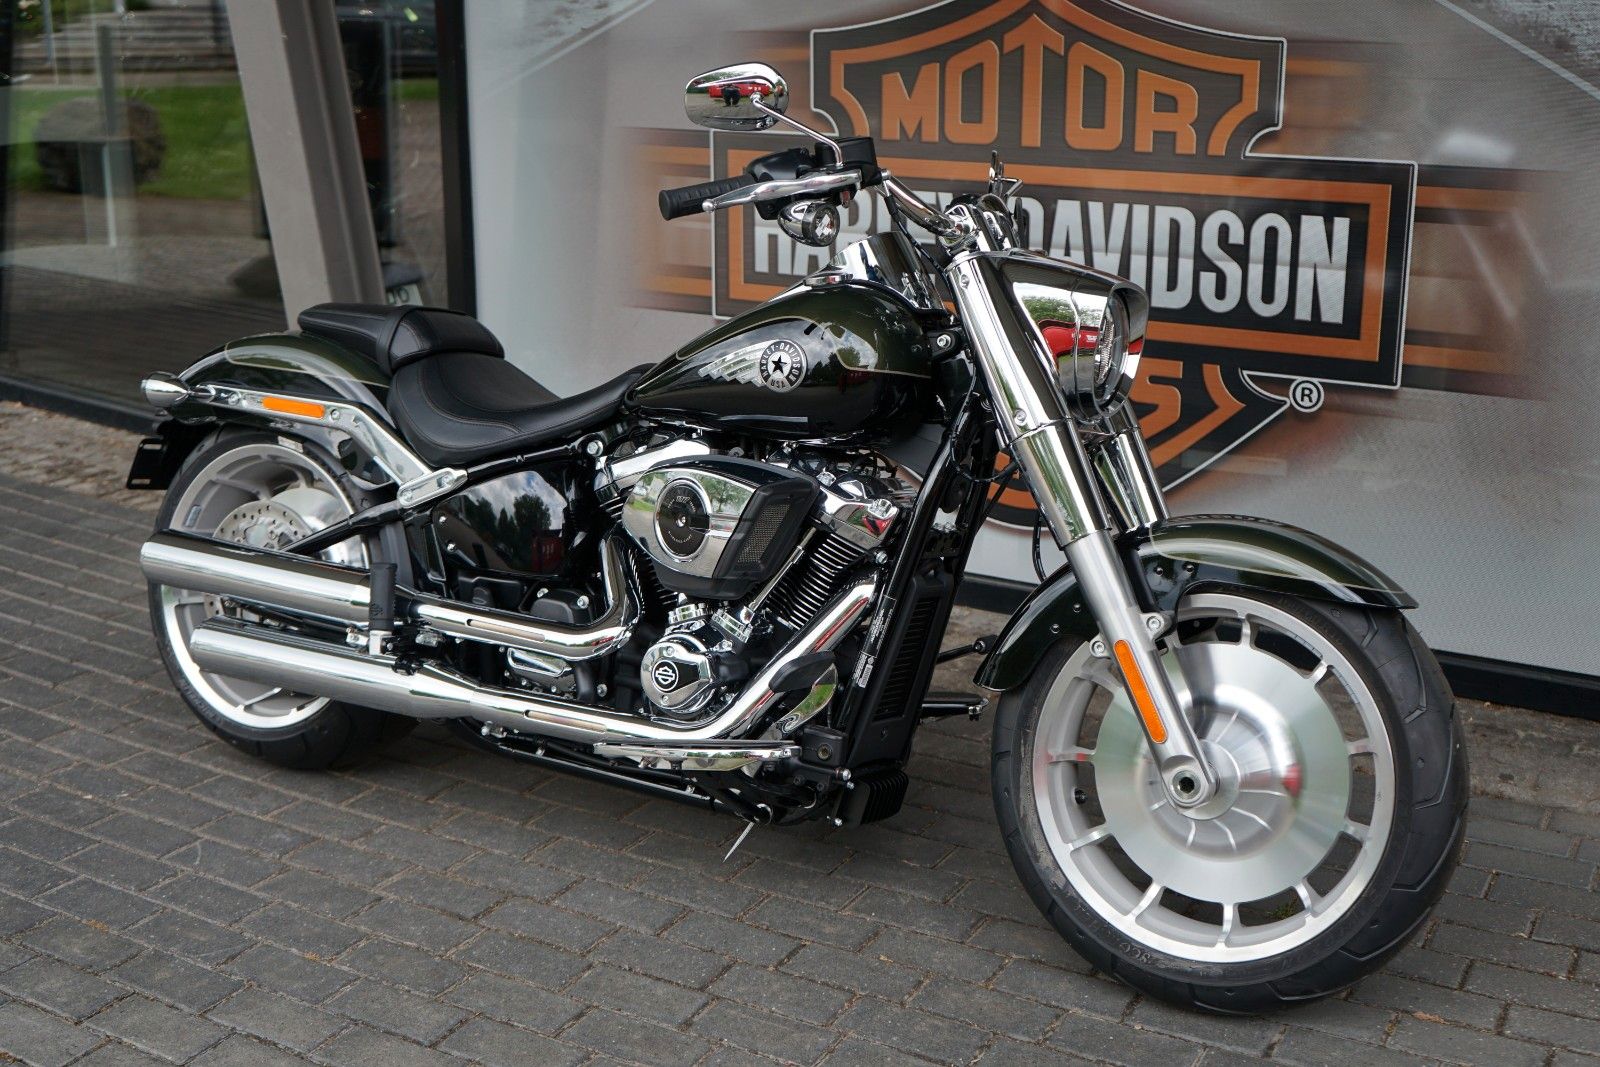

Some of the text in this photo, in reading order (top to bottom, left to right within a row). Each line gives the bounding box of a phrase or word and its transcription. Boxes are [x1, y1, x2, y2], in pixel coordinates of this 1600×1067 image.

[881, 17, 1198, 155] MOTOR
[753, 188, 1351, 325] HREDAVIDSON
[761, 342, 801, 382] HARLEY-DAVIDSON
[770, 379, 786, 389] USA
